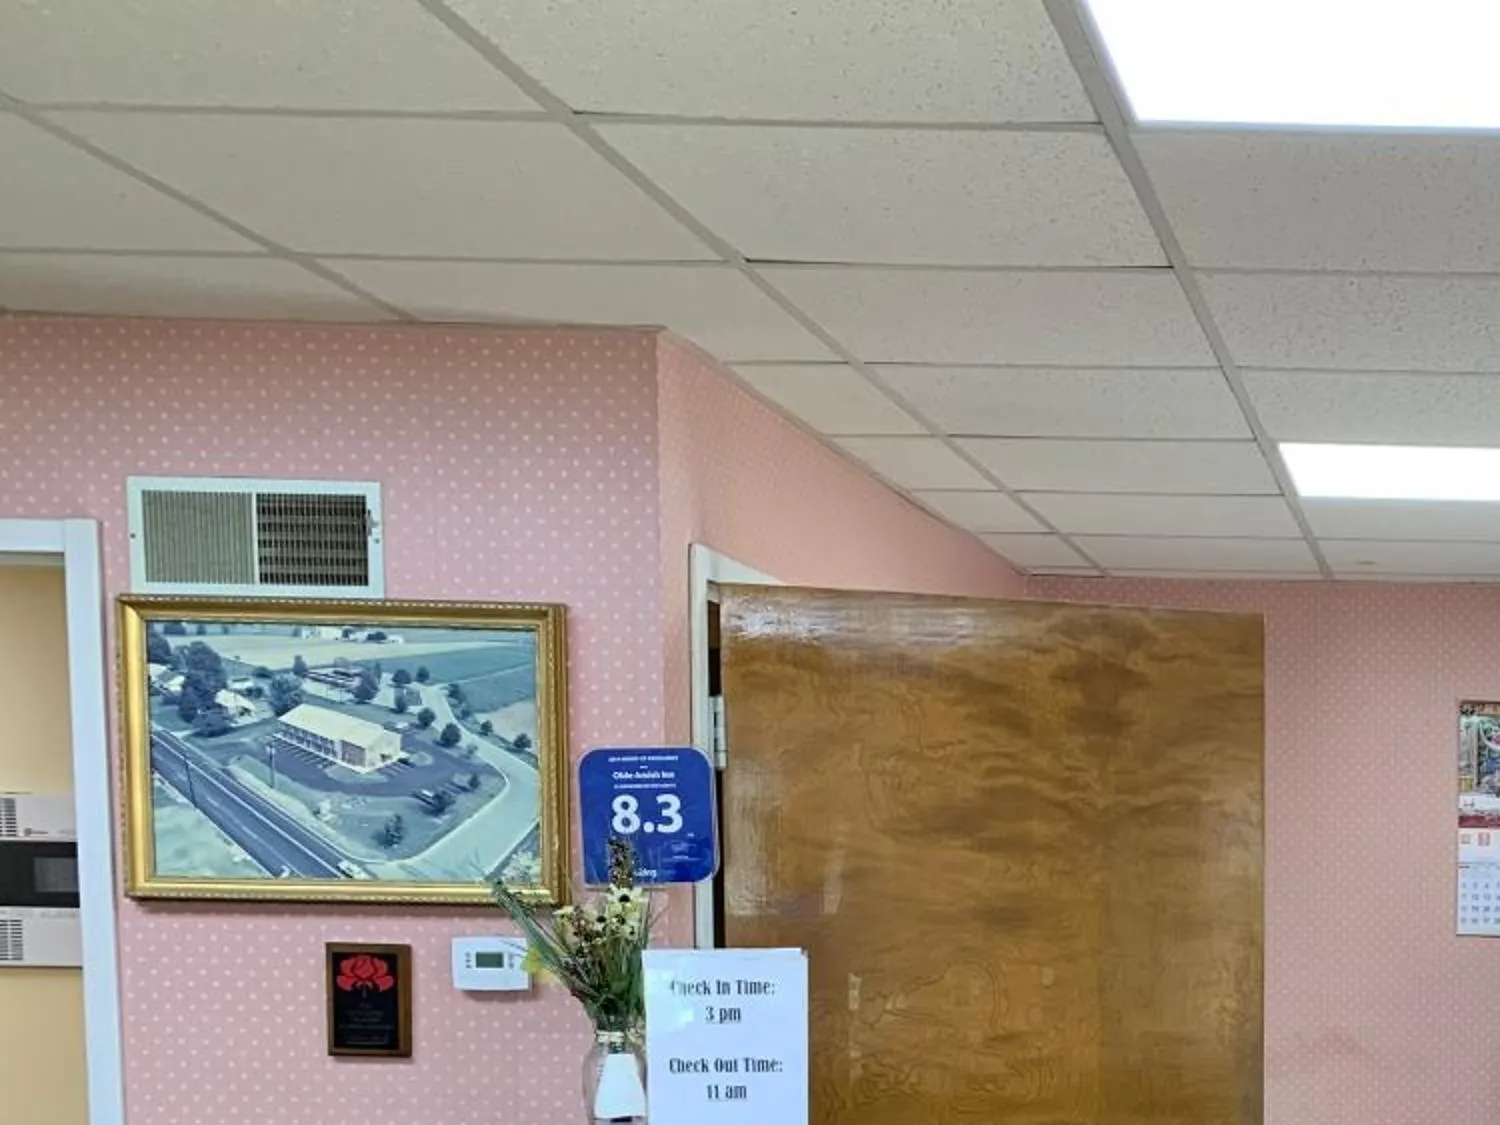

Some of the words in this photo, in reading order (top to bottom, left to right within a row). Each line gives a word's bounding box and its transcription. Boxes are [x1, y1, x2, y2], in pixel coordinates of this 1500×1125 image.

[611, 793, 684, 835] 8.3
[716, 979, 731, 995] In
[736, 979, 775, 995] Time:
[705, 1006, 714, 1022] 3
[719, 1007, 741, 1024] pm
[669, 1057, 709, 1073] Check
[714, 1057, 738, 1073] Out
[742, 1057, 783, 1073] Time:
[707, 1084, 720, 1100] 11
[725, 1084, 748, 1100] am
